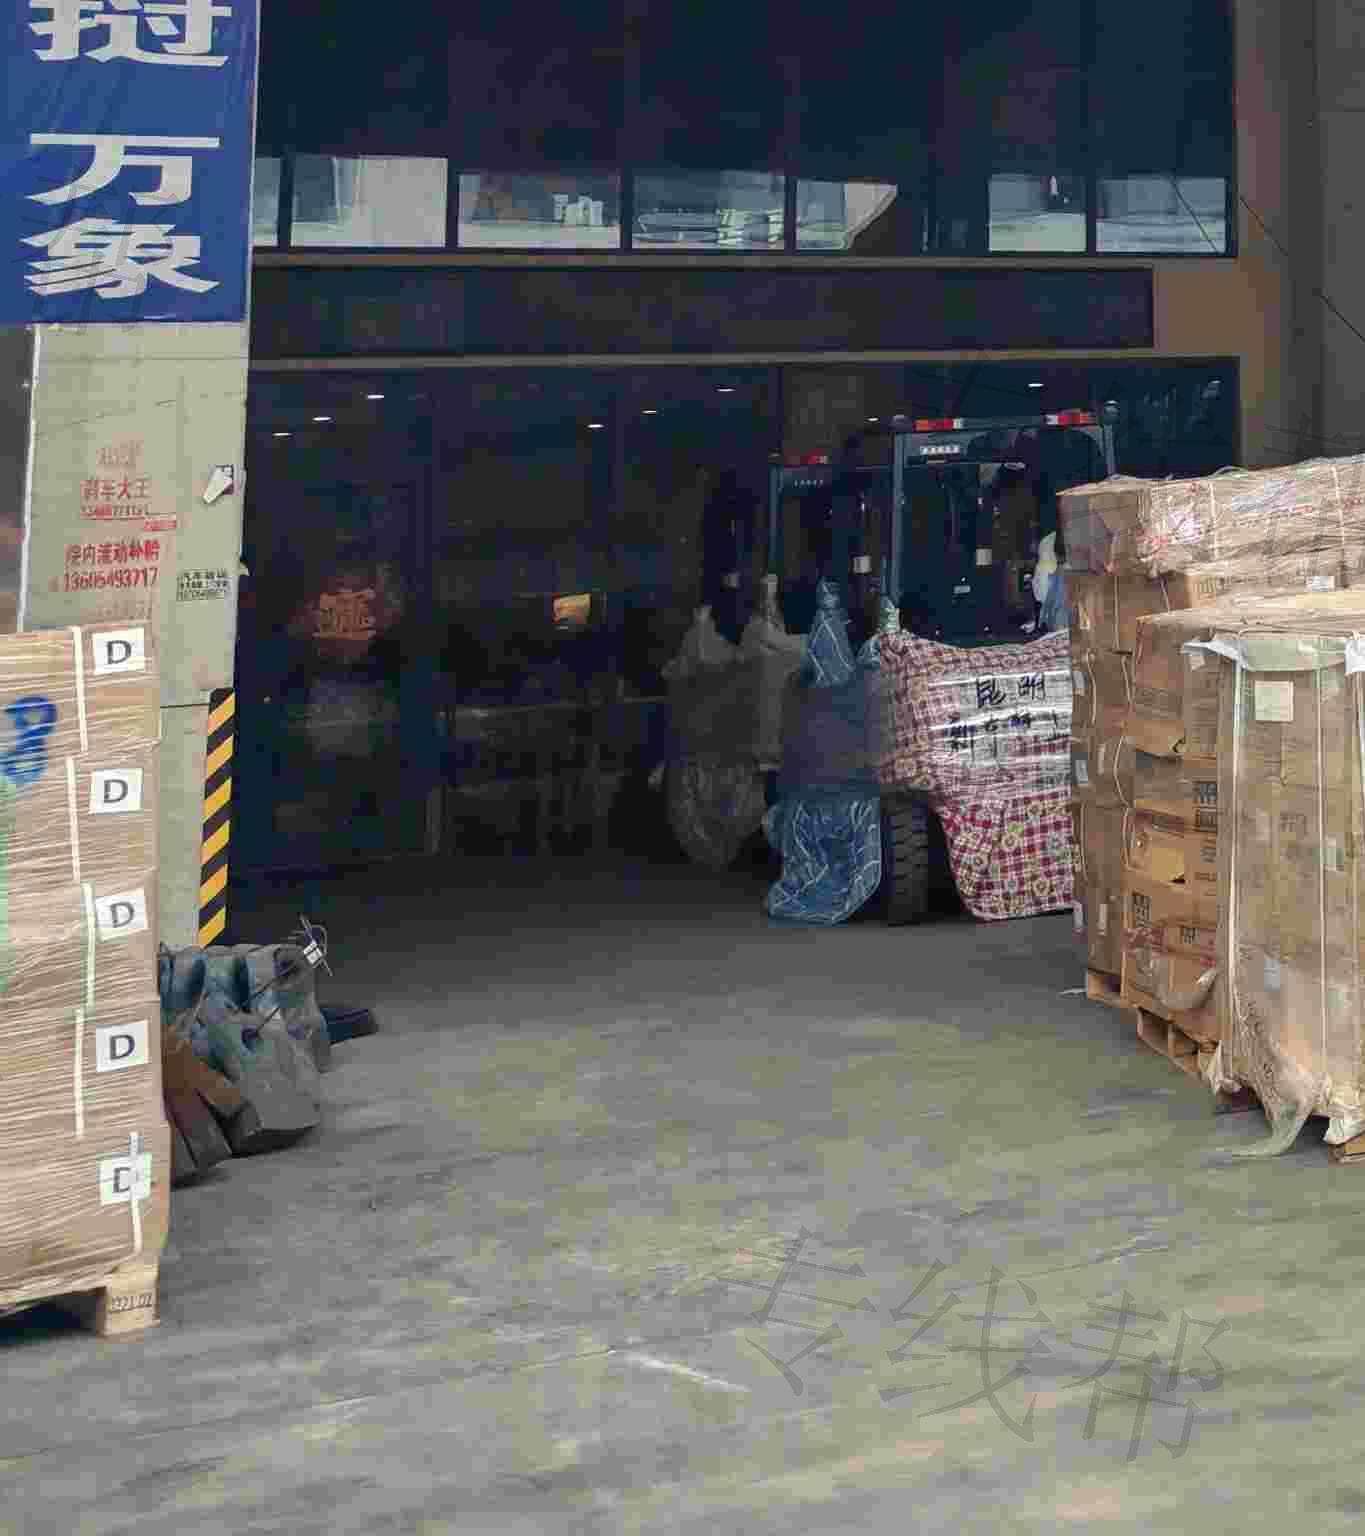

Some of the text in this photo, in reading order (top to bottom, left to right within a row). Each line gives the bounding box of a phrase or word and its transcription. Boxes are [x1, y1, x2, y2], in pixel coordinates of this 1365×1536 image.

[19, 132, 222, 298] 万象
[106, 640, 133, 665] D
[103, 778, 129, 803] D
[109, 901, 135, 927] D
[108, 1034, 136, 1061] D
